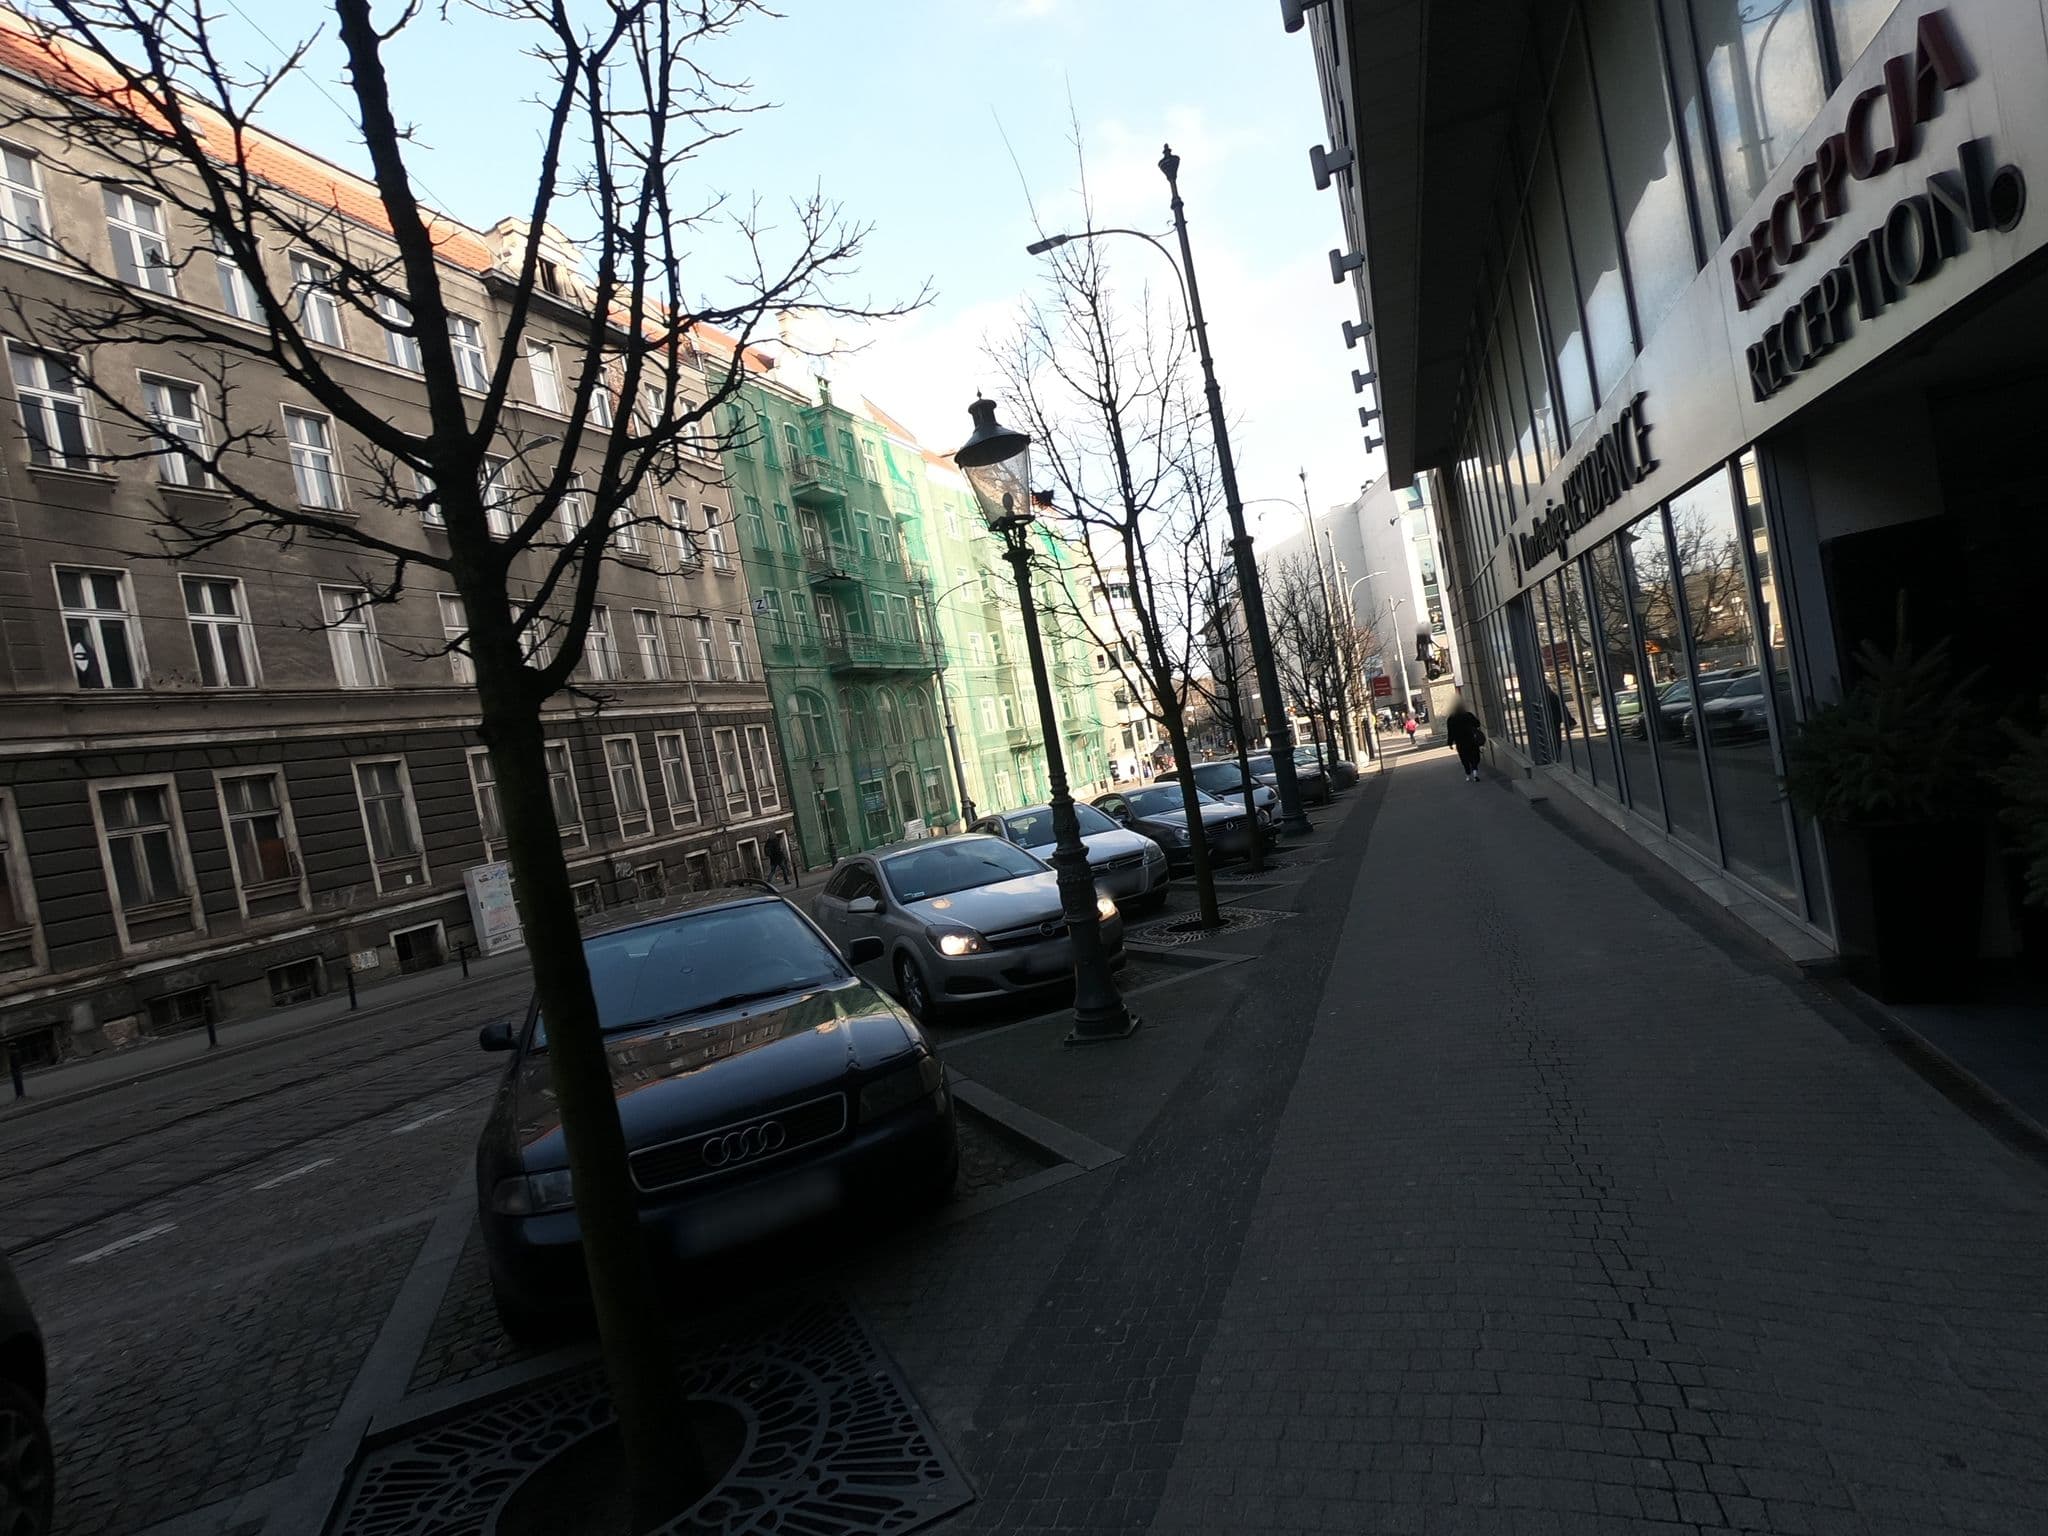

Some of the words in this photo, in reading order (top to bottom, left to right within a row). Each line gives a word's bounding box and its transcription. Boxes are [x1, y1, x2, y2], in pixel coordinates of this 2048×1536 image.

[1731, 11, 1967, 312] RECEPCJA
[1746, 139, 1990, 403] RECEPTION
[1563, 391, 1659, 534] RESIDENCE
